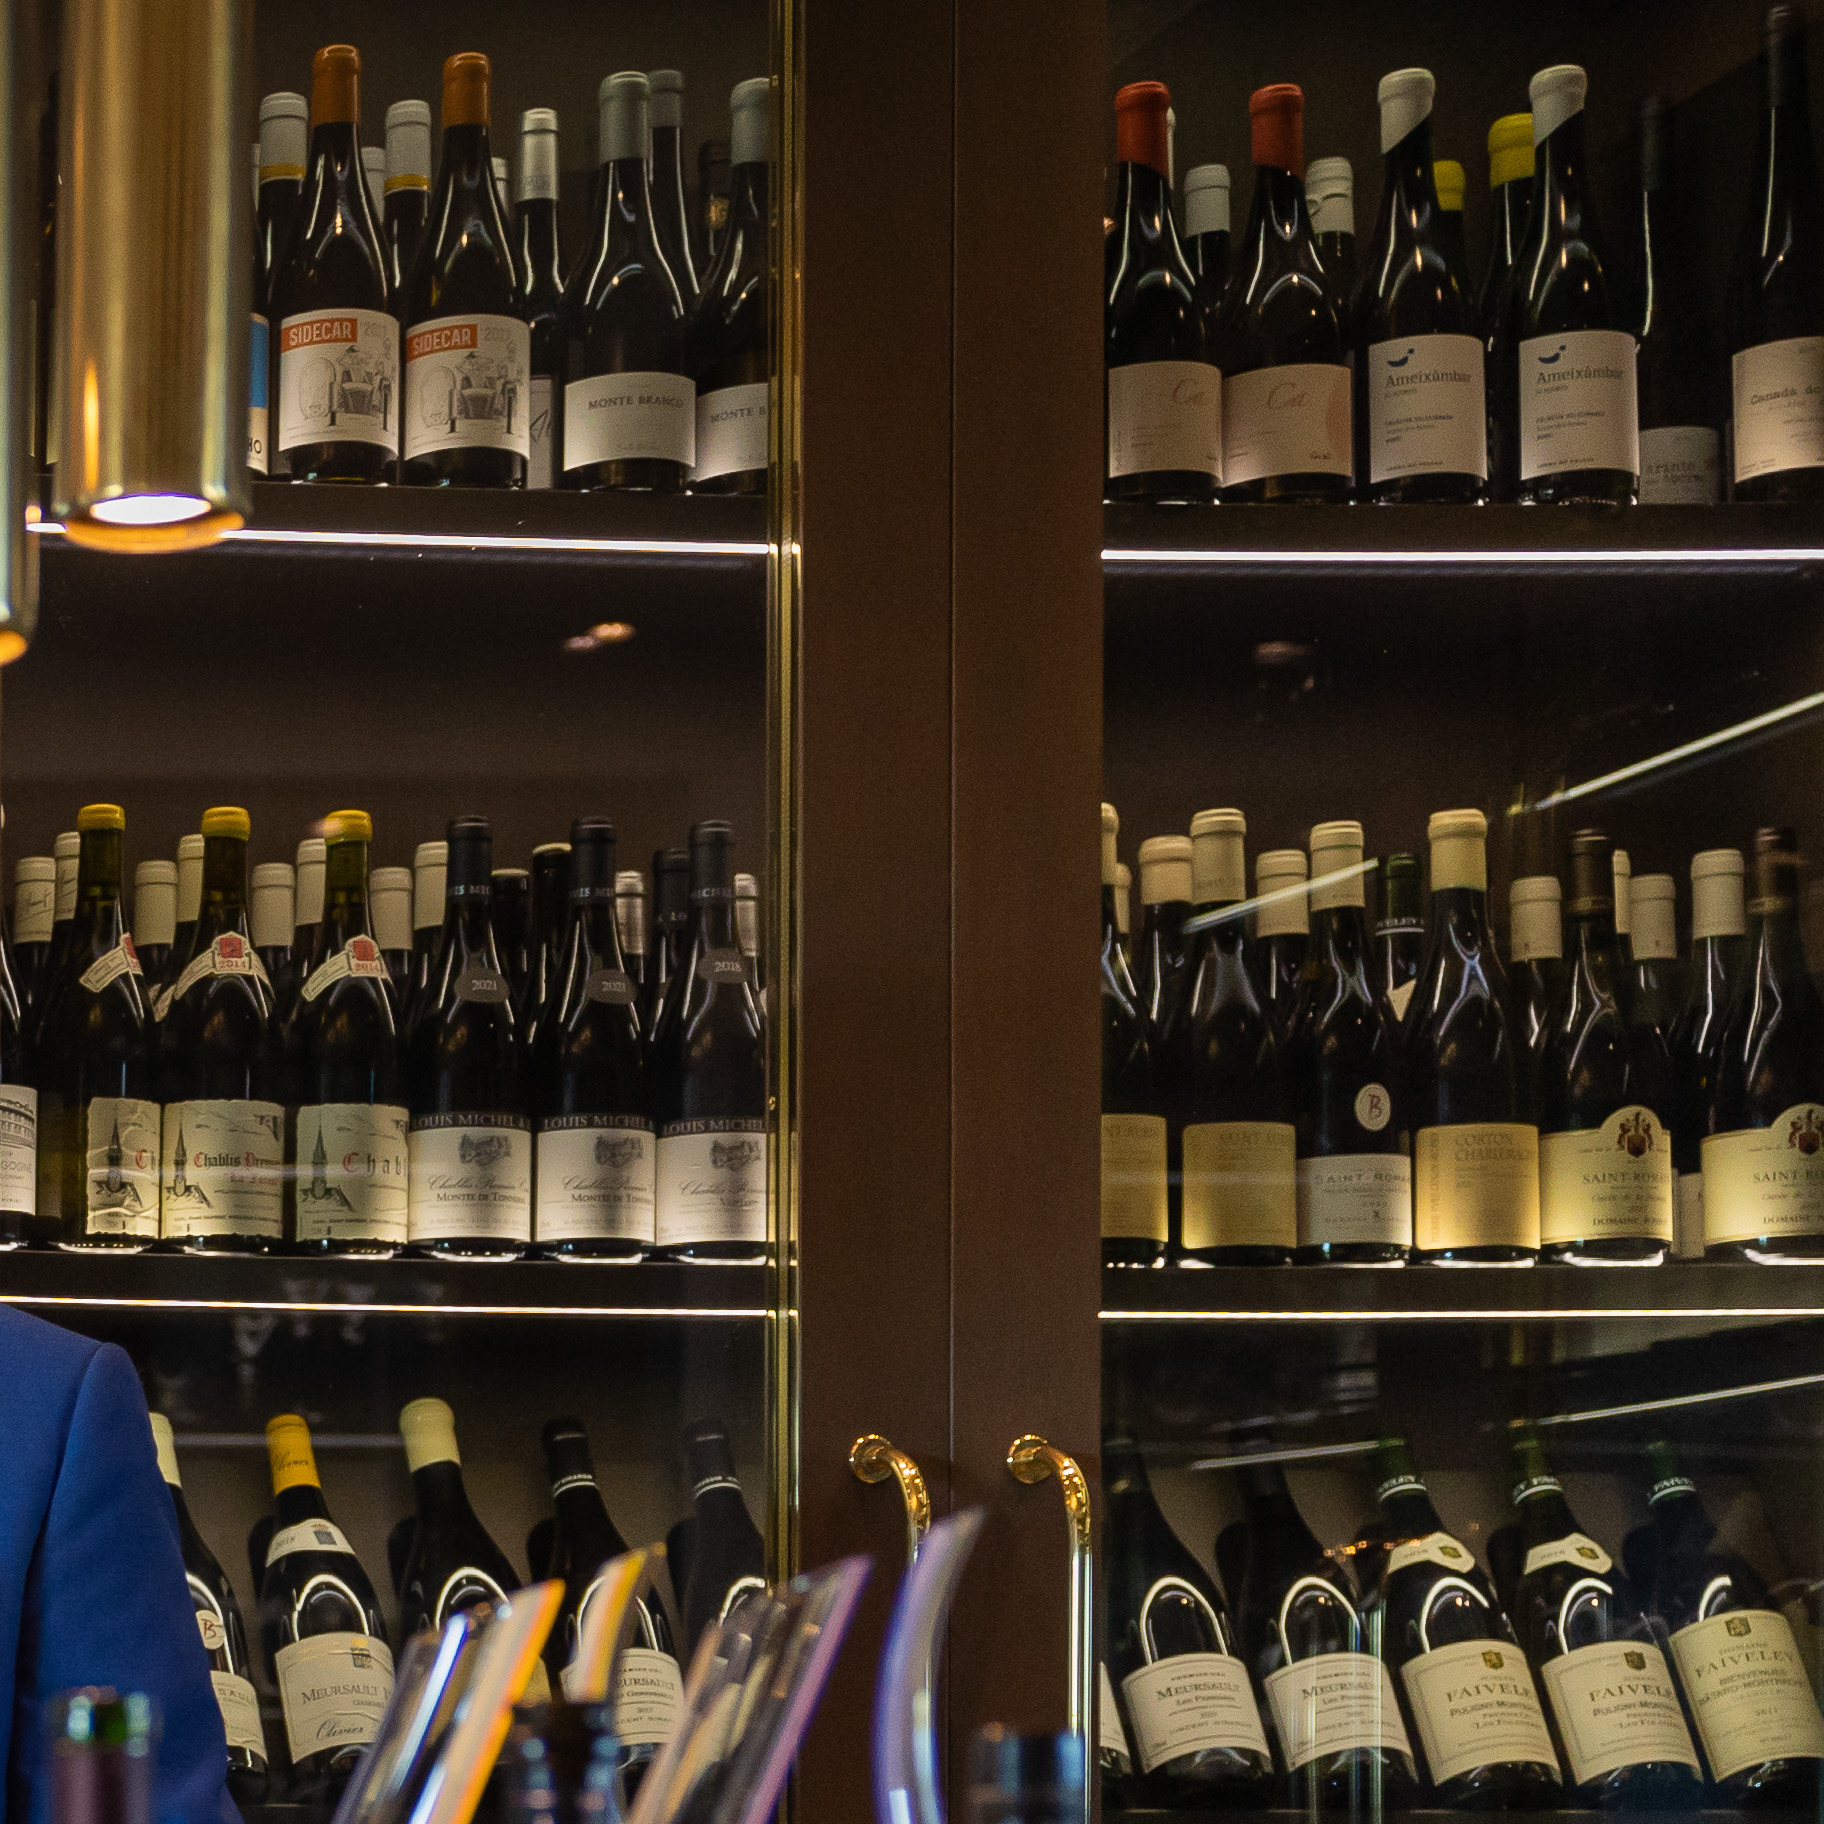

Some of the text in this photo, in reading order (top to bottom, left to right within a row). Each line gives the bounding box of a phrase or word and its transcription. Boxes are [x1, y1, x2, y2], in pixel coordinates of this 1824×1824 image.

[289, 319, 352, 347] SIDECAR
[413, 327, 471, 355] SIDECAR
[588, 396, 633, 410] MONTE
[412, 1114, 517, 1127] LOUIS MICHEL
[543, 1116, 588, 1130] LOUIS
[662, 1120, 706, 1134] LOUIS
[194, 1151, 241, 1168] Chablis
[1314, 1173, 1363, 1186] SAINT
[301, 1684, 378, 1705] MEURSAULT
[1156, 1681, 1240, 1701] MEURSAULT
